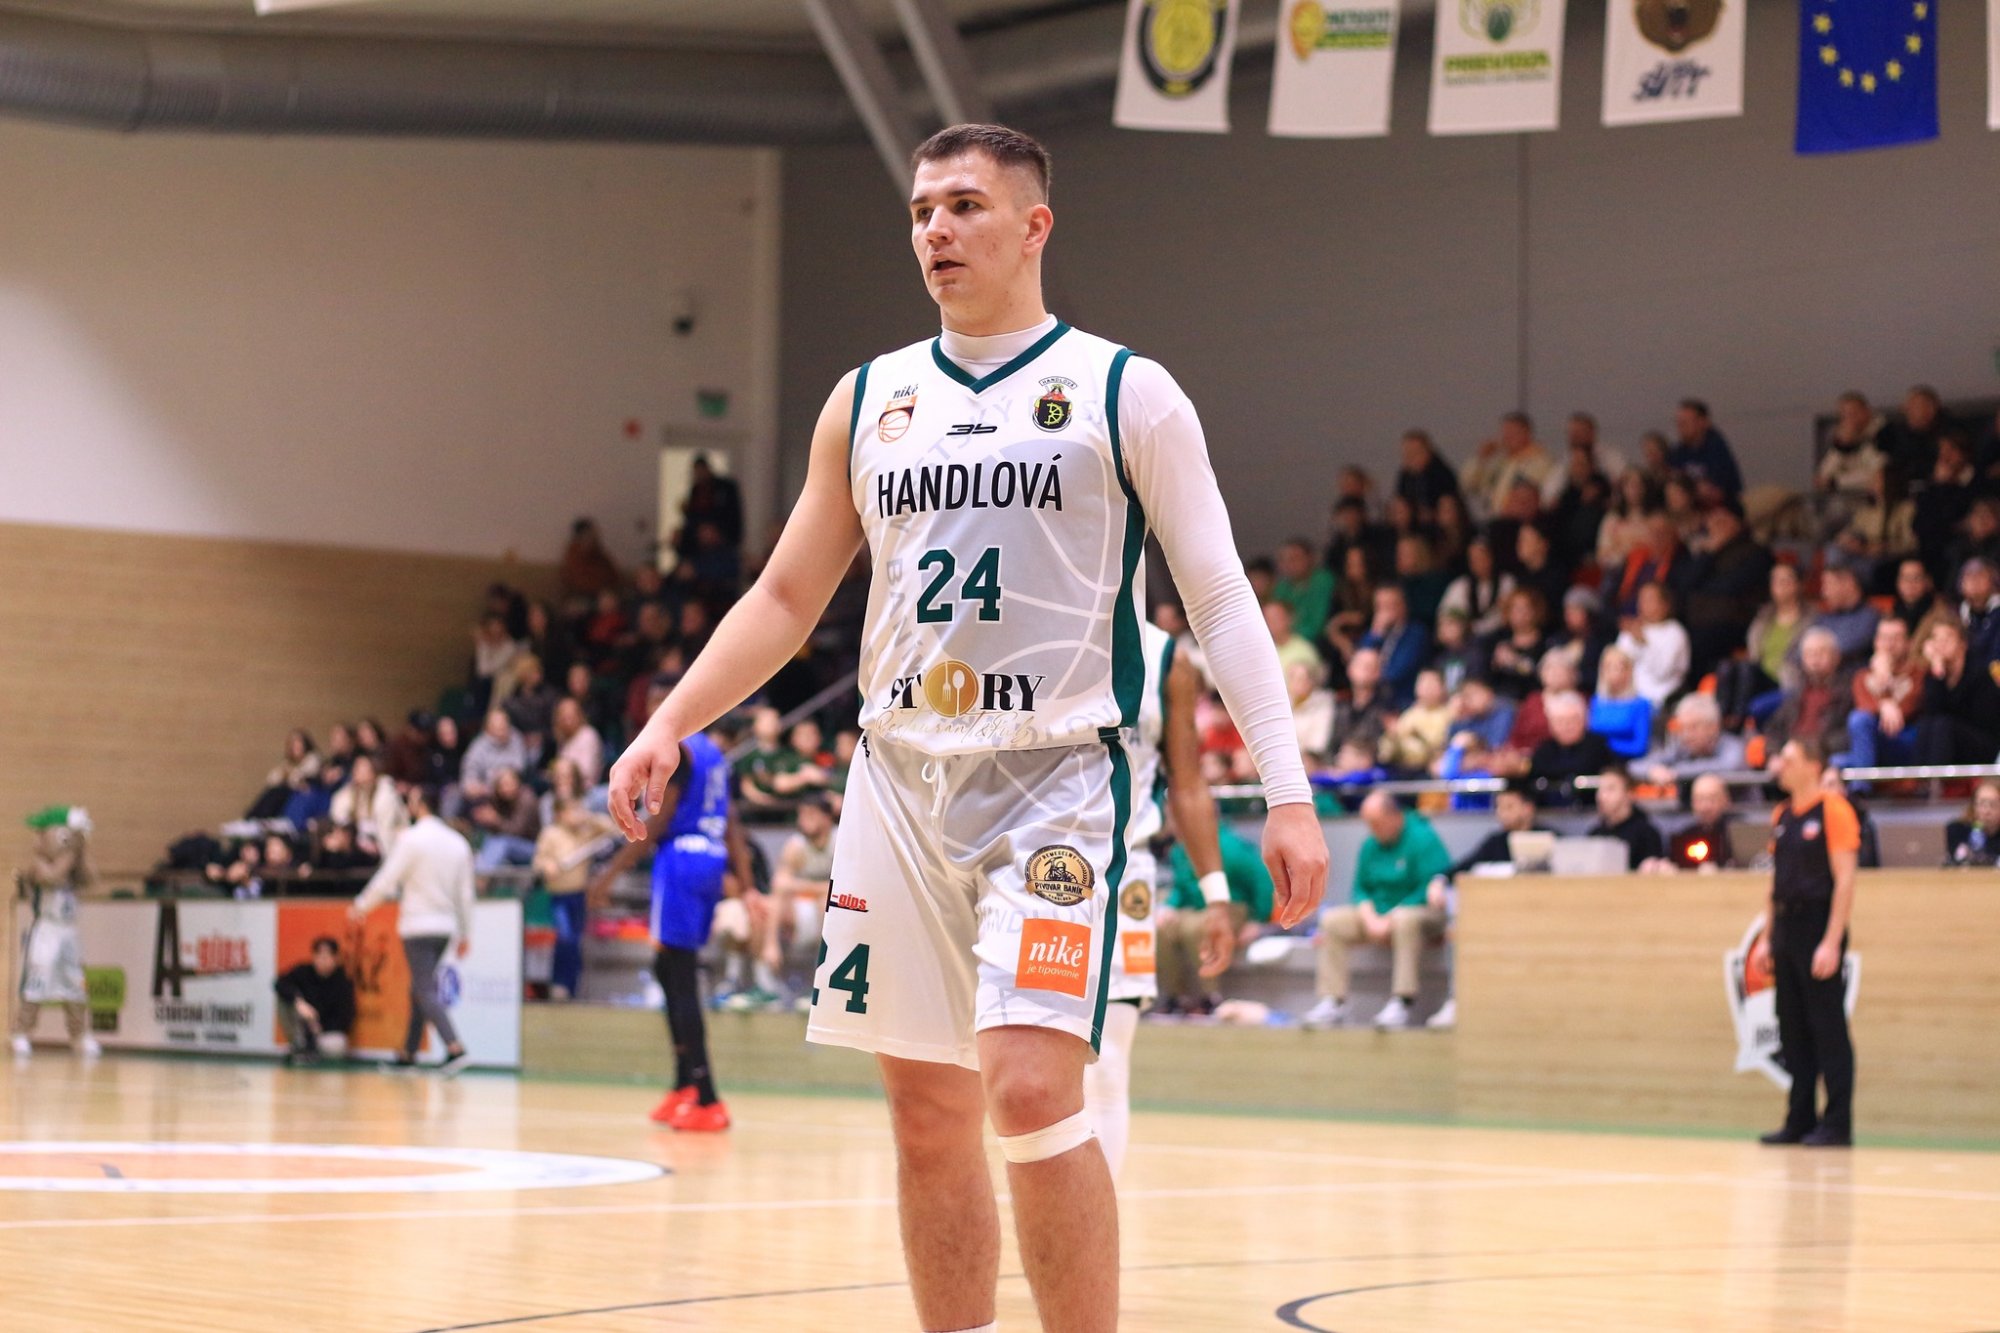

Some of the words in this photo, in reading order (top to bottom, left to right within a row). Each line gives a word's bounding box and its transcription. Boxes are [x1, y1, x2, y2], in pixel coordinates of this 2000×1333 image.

[892, 383, 919, 399] niké
[878, 453, 1063, 519] HANDLOVÁ
[916, 547, 1002, 624] 24
[1035, 882, 1062, 892] PIVOVAR
[1063, 884, 1084, 896] BANÍK
[1029, 935, 1084, 967] niké
[1026, 964, 1037, 975] je
[1038, 965, 1080, 978] tipovanie
